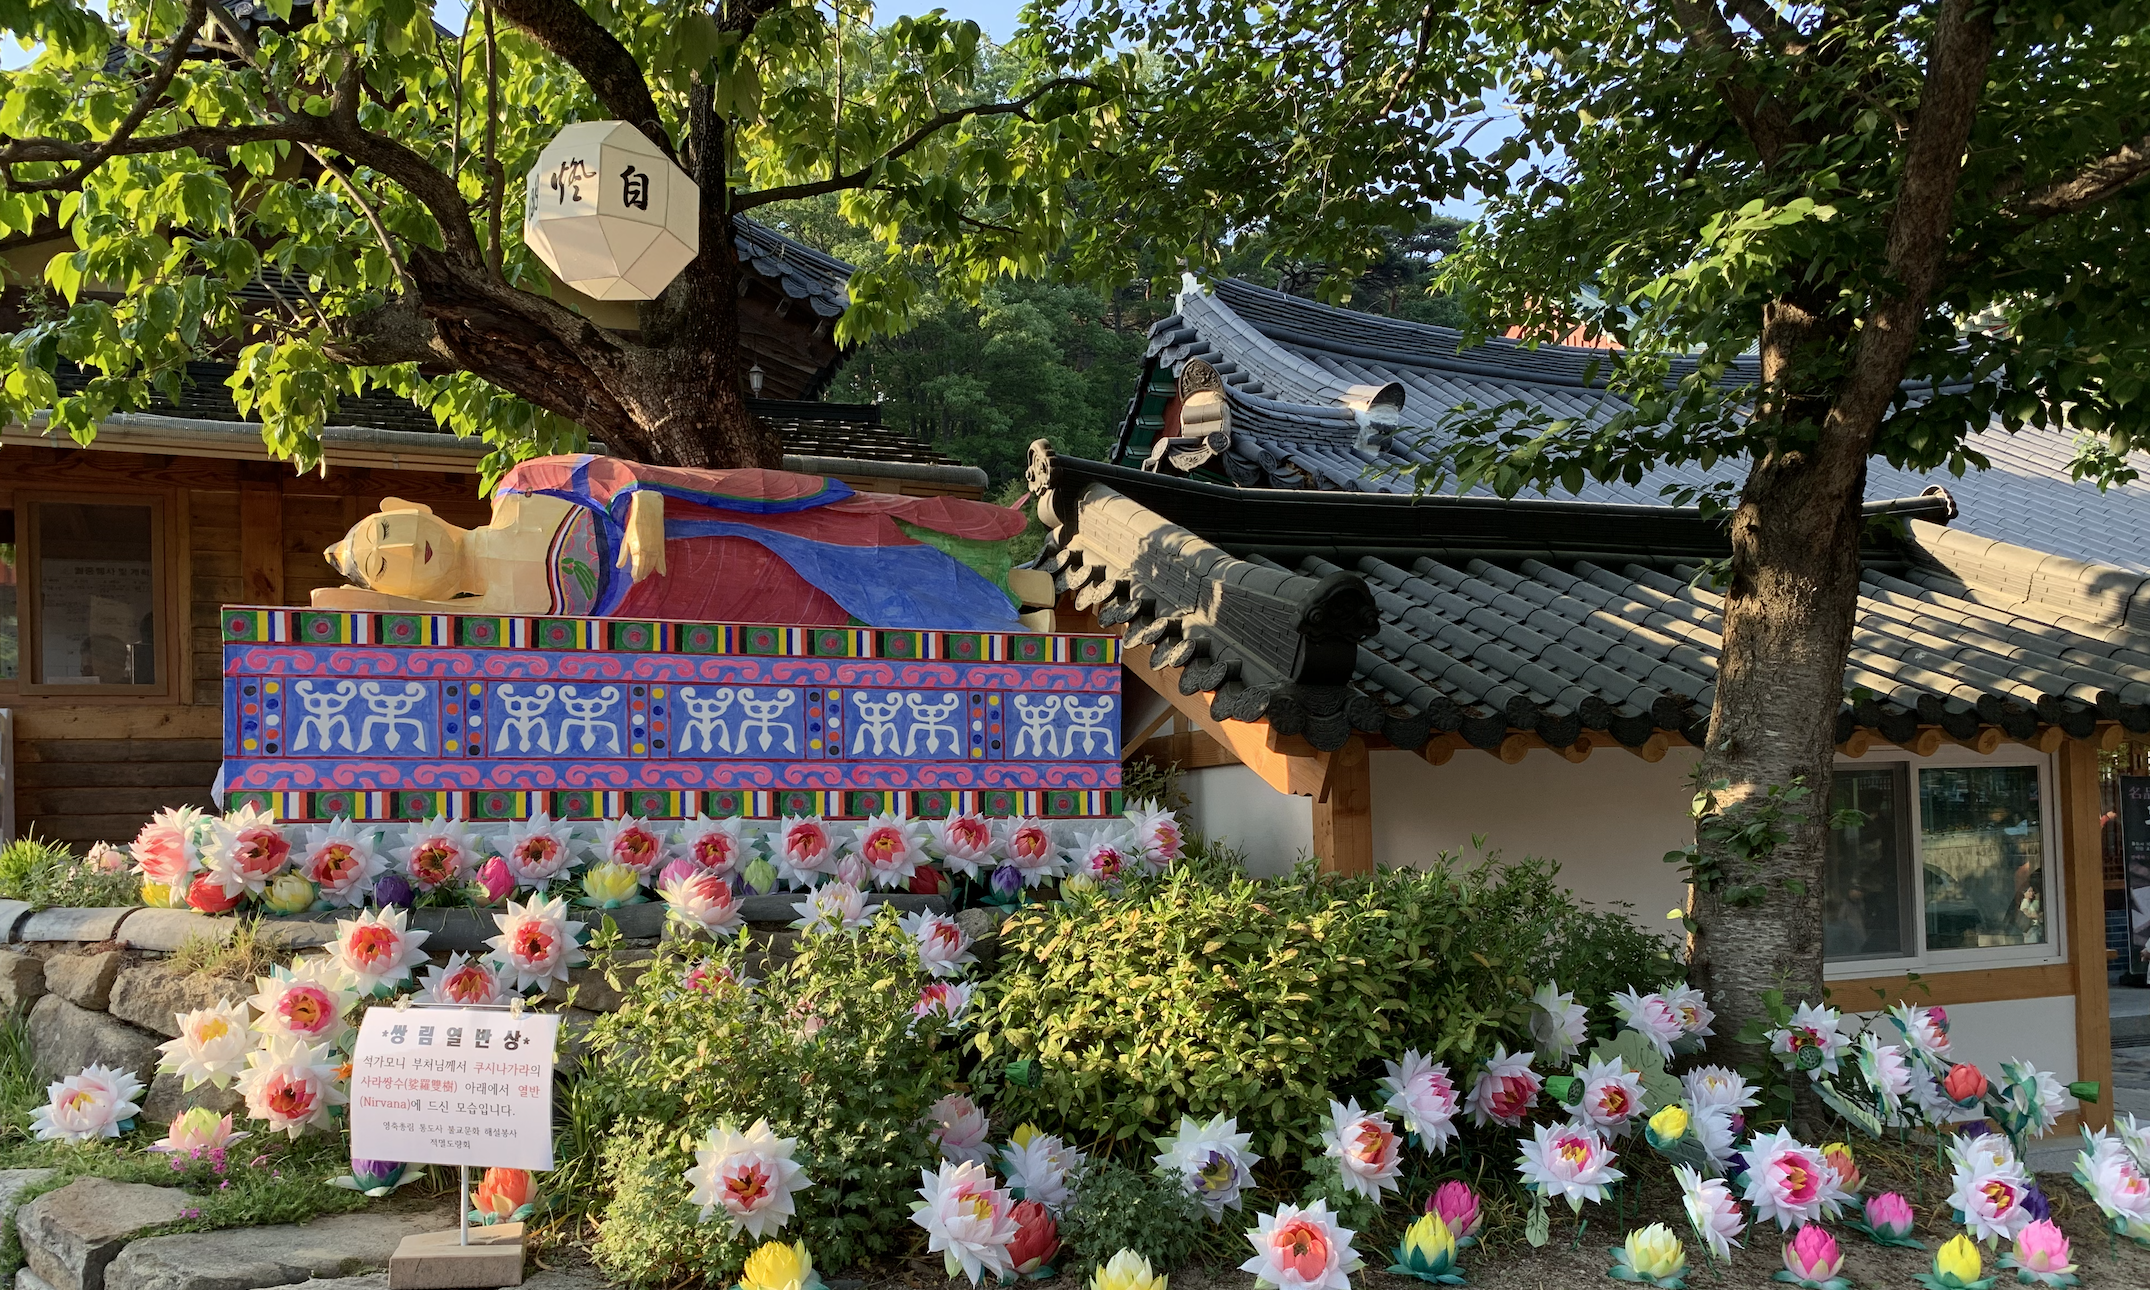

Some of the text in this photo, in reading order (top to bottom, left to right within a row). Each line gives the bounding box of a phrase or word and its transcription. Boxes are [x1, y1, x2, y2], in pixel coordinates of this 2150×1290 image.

[620, 165, 650, 211] 自
[131, 568, 153, 577] 계획
[418, 1026, 435, 1046] 림
[446, 1027, 463, 1047] 열
[474, 1028, 492, 1049] 반
[363, 1055, 541, 1078] 석가모니 부처님께서 쿠시나가라의
[464, 1081, 509, 1097] 아래에서
[518, 1084, 541, 1099] 열반
[359, 1095, 516, 1117] (Nirvana)에 드신 모습입니다.
[382, 1120, 517, 1138] 영축총림 통도사 불교문화 해설봉사
[430, 1138, 471, 1149] 적멸도량회
